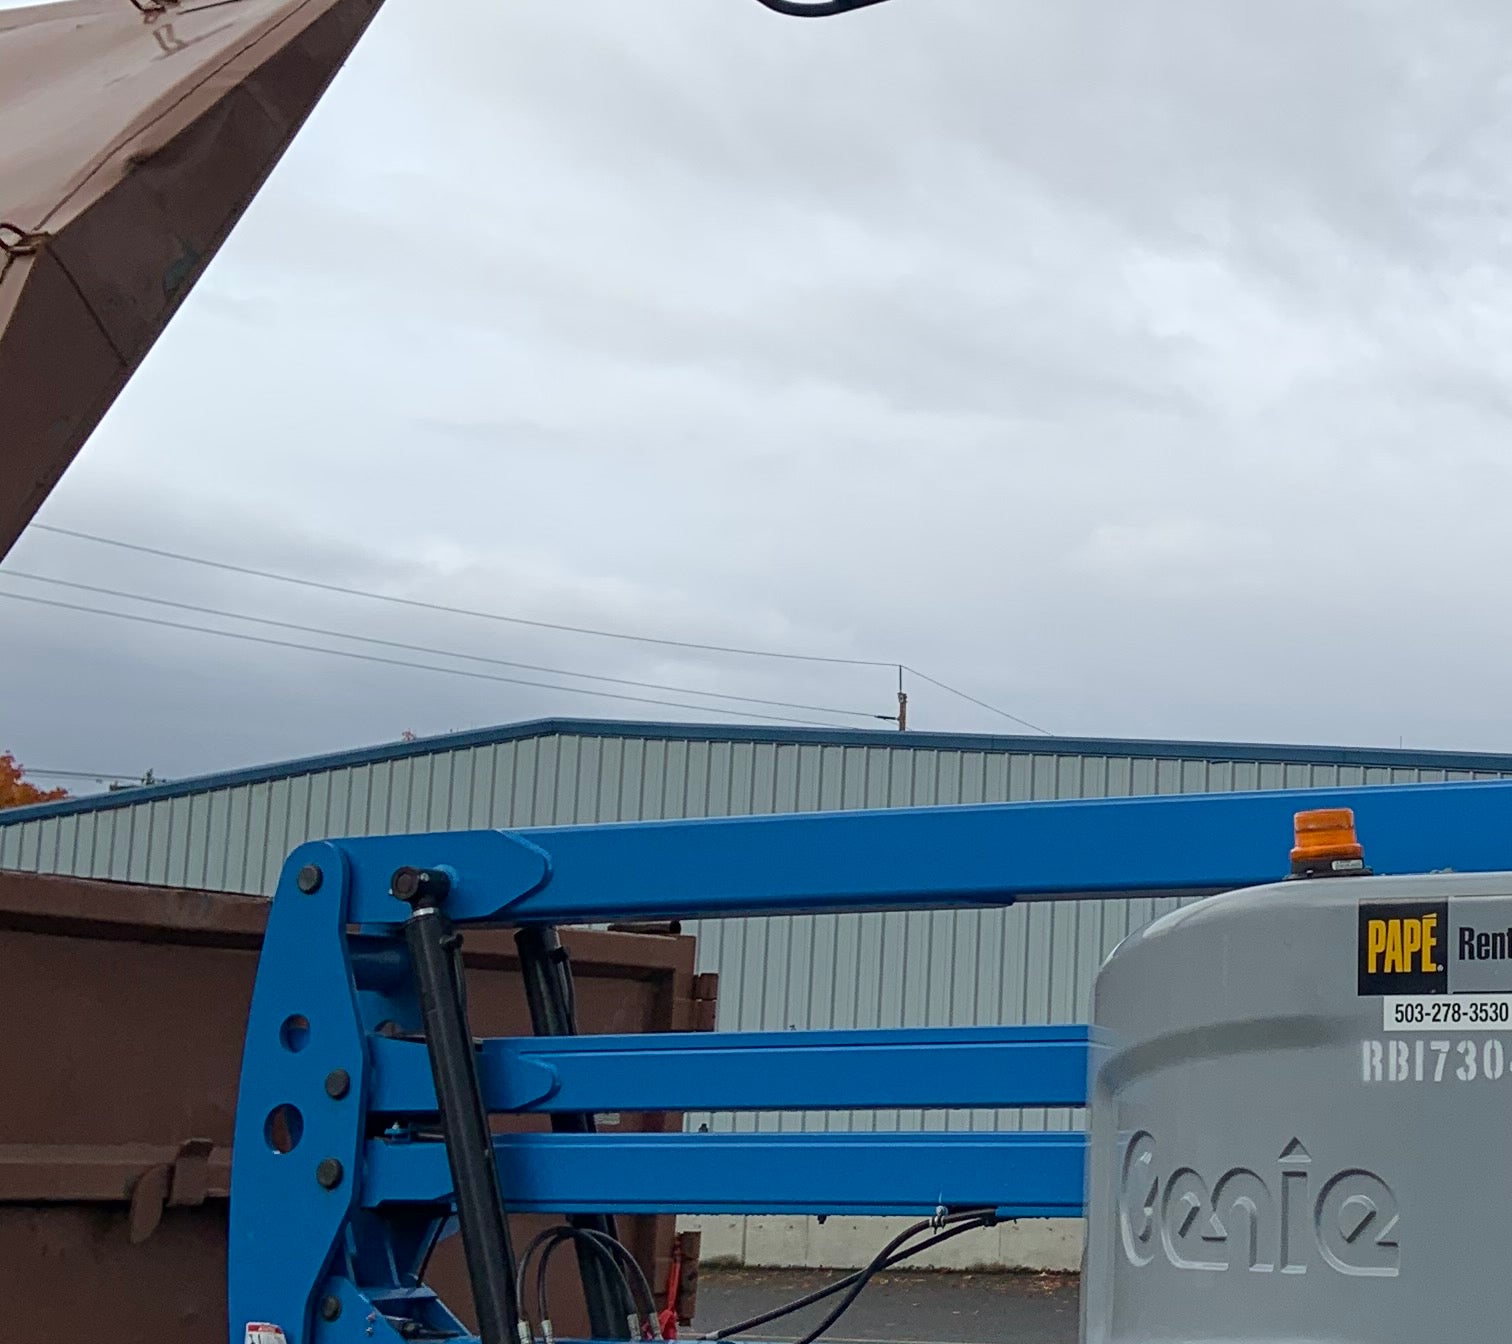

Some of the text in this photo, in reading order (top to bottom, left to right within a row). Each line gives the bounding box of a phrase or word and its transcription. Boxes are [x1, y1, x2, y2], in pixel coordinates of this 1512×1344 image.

[1367, 912, 1438, 974] PAPÉ
[1394, 1002, 1510, 1023] 503-278-3530
[1118, 1129, 1400, 1278] Genie
